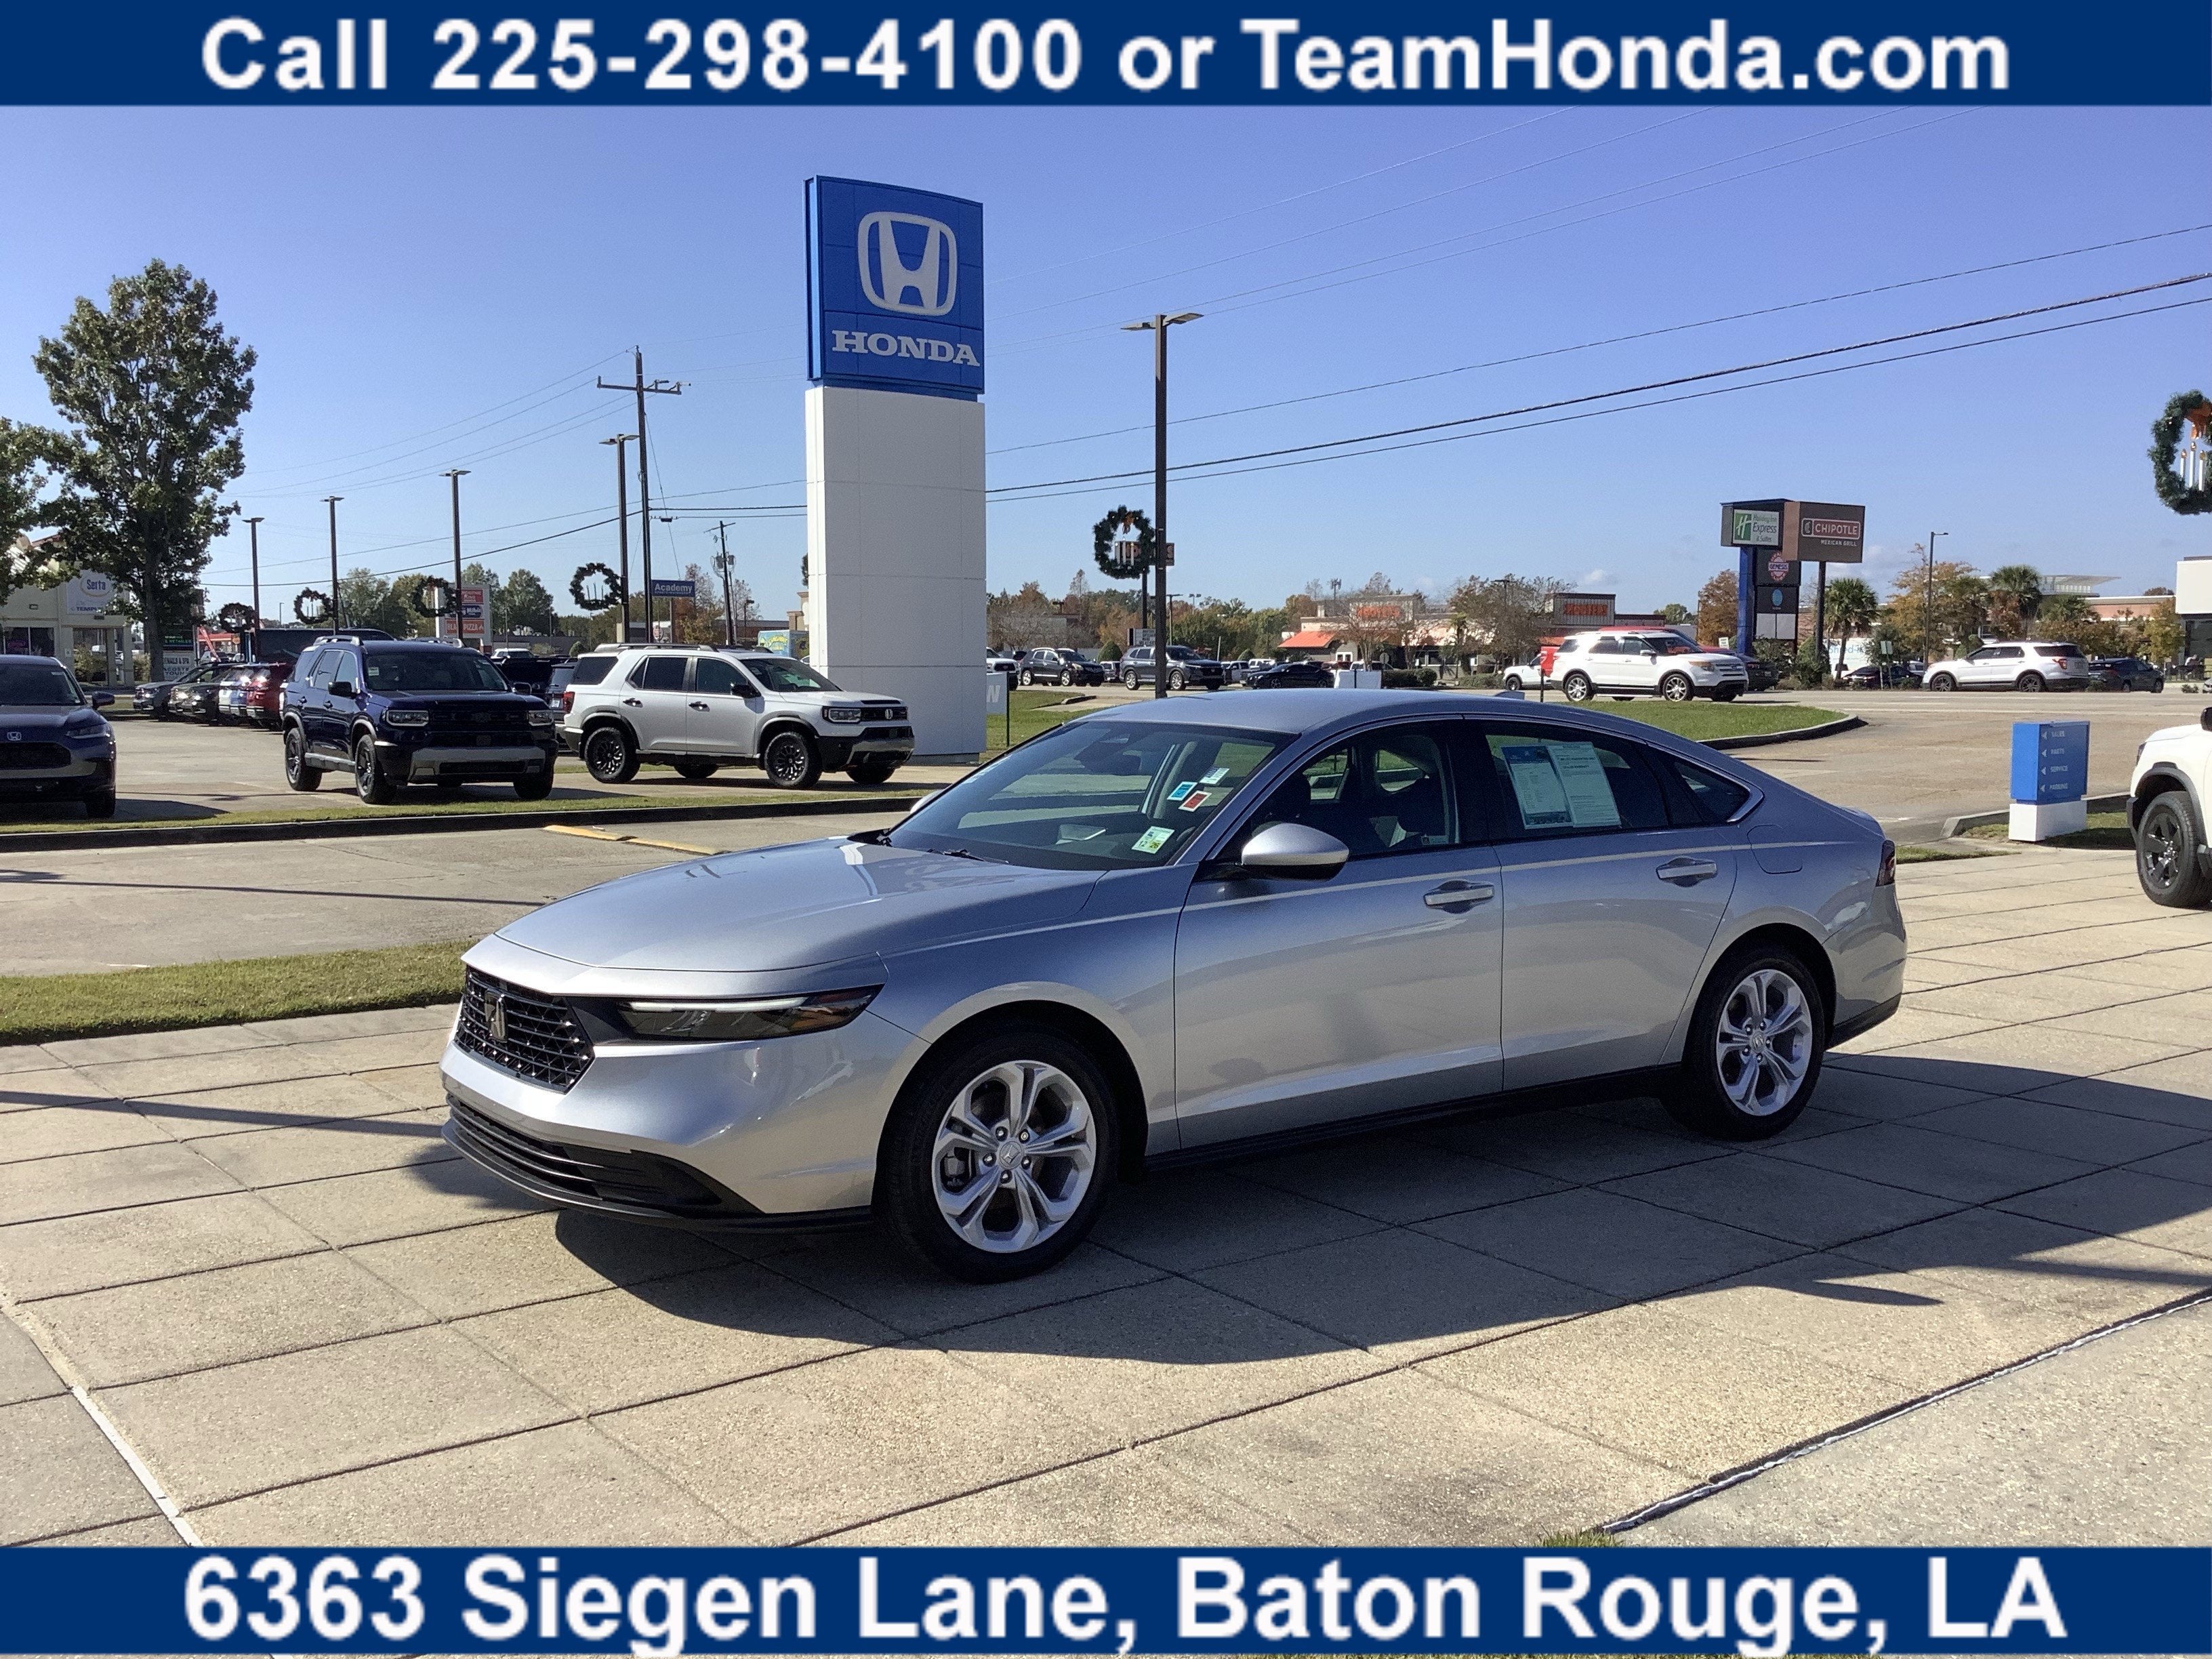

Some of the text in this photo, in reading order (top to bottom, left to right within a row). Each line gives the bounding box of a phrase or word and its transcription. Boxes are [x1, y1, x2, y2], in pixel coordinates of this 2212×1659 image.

[832, 329, 980, 367] HONDA
[1753, 522, 1778, 535] Express
[1815, 523, 1858, 535] CHIPOTLE
[86, 579, 106, 590] Serta
[654, 583, 693, 594] Academy
